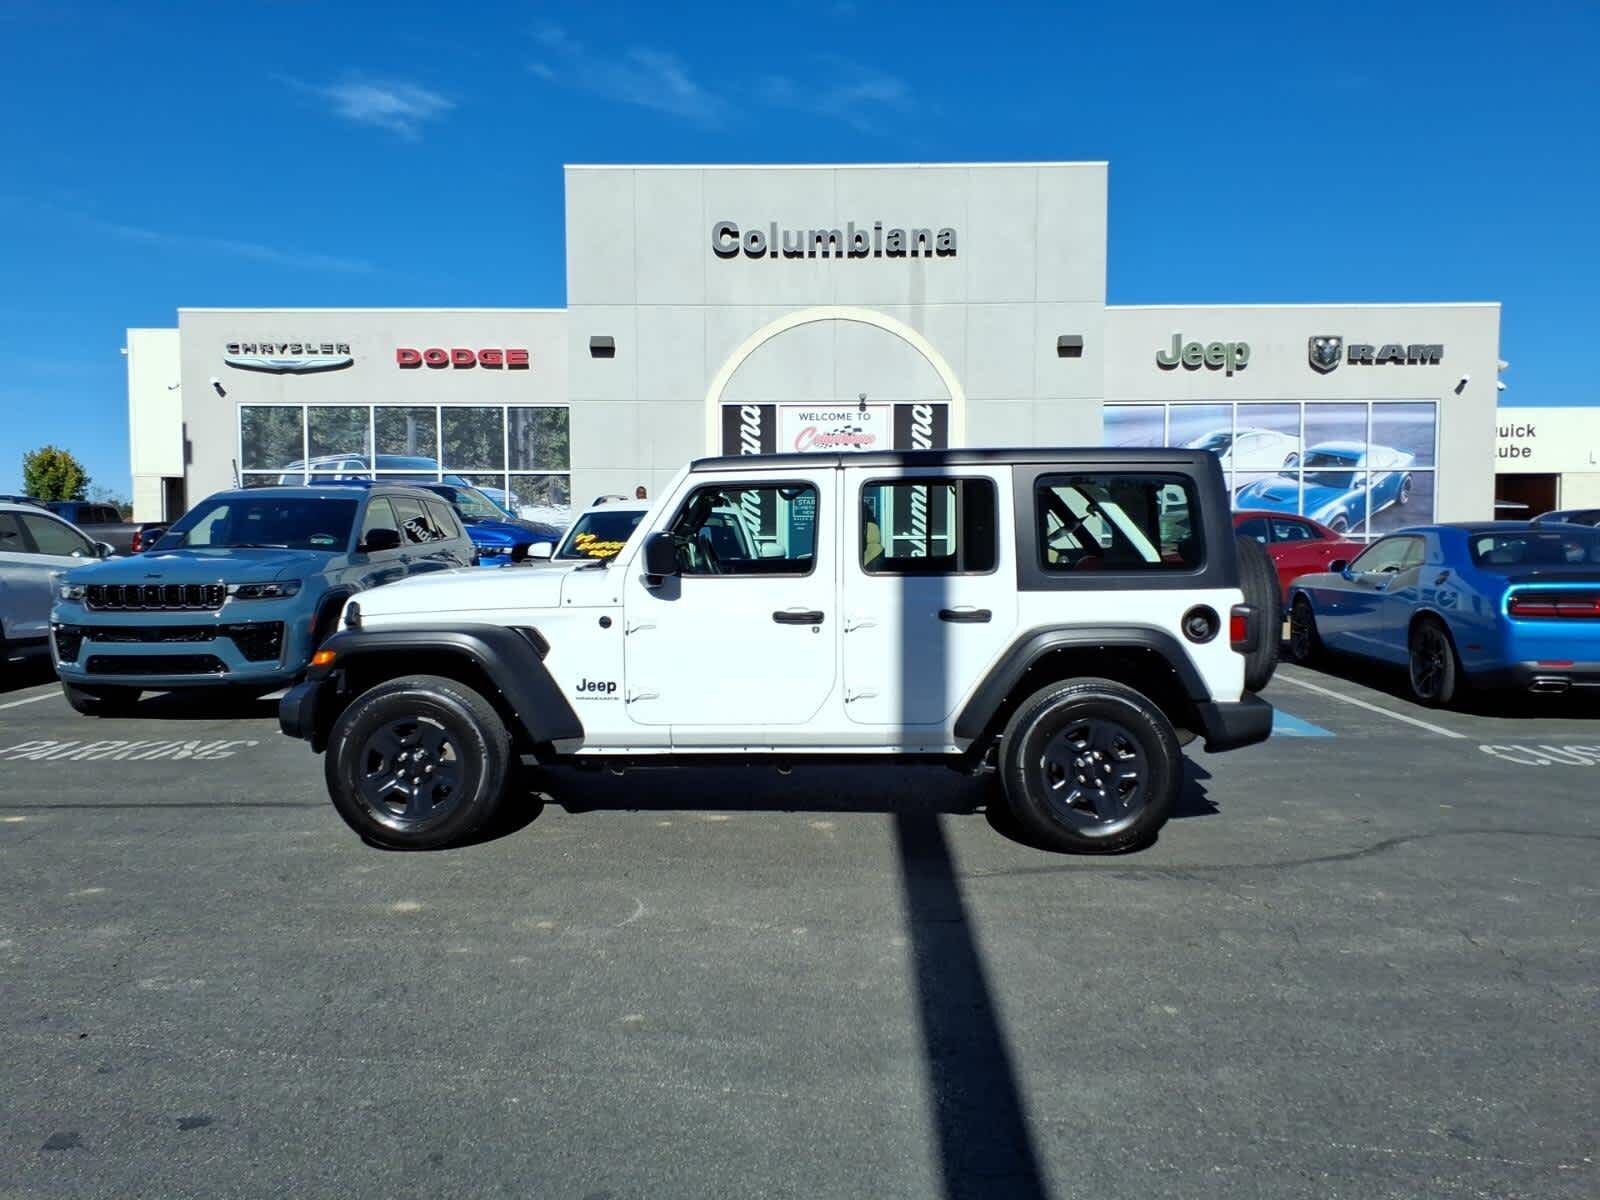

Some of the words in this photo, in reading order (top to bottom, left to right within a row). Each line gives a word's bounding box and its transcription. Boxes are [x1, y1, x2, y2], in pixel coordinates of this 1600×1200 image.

[712, 221, 957, 259] Columbiana
[225, 342, 350, 355] CHRYSLER
[1156, 333, 1250, 377] Jeep
[1347, 344, 1444, 366] RAM
[396, 348, 530, 370] DODGE
[798, 413, 853, 421] WELCOME
[857, 413, 871, 421] TO
[1495, 424, 1536, 438] uick
[1495, 444, 1532, 458] ube
[576, 678, 617, 694] Jeep
[0, 741, 259, 760] PARKING
